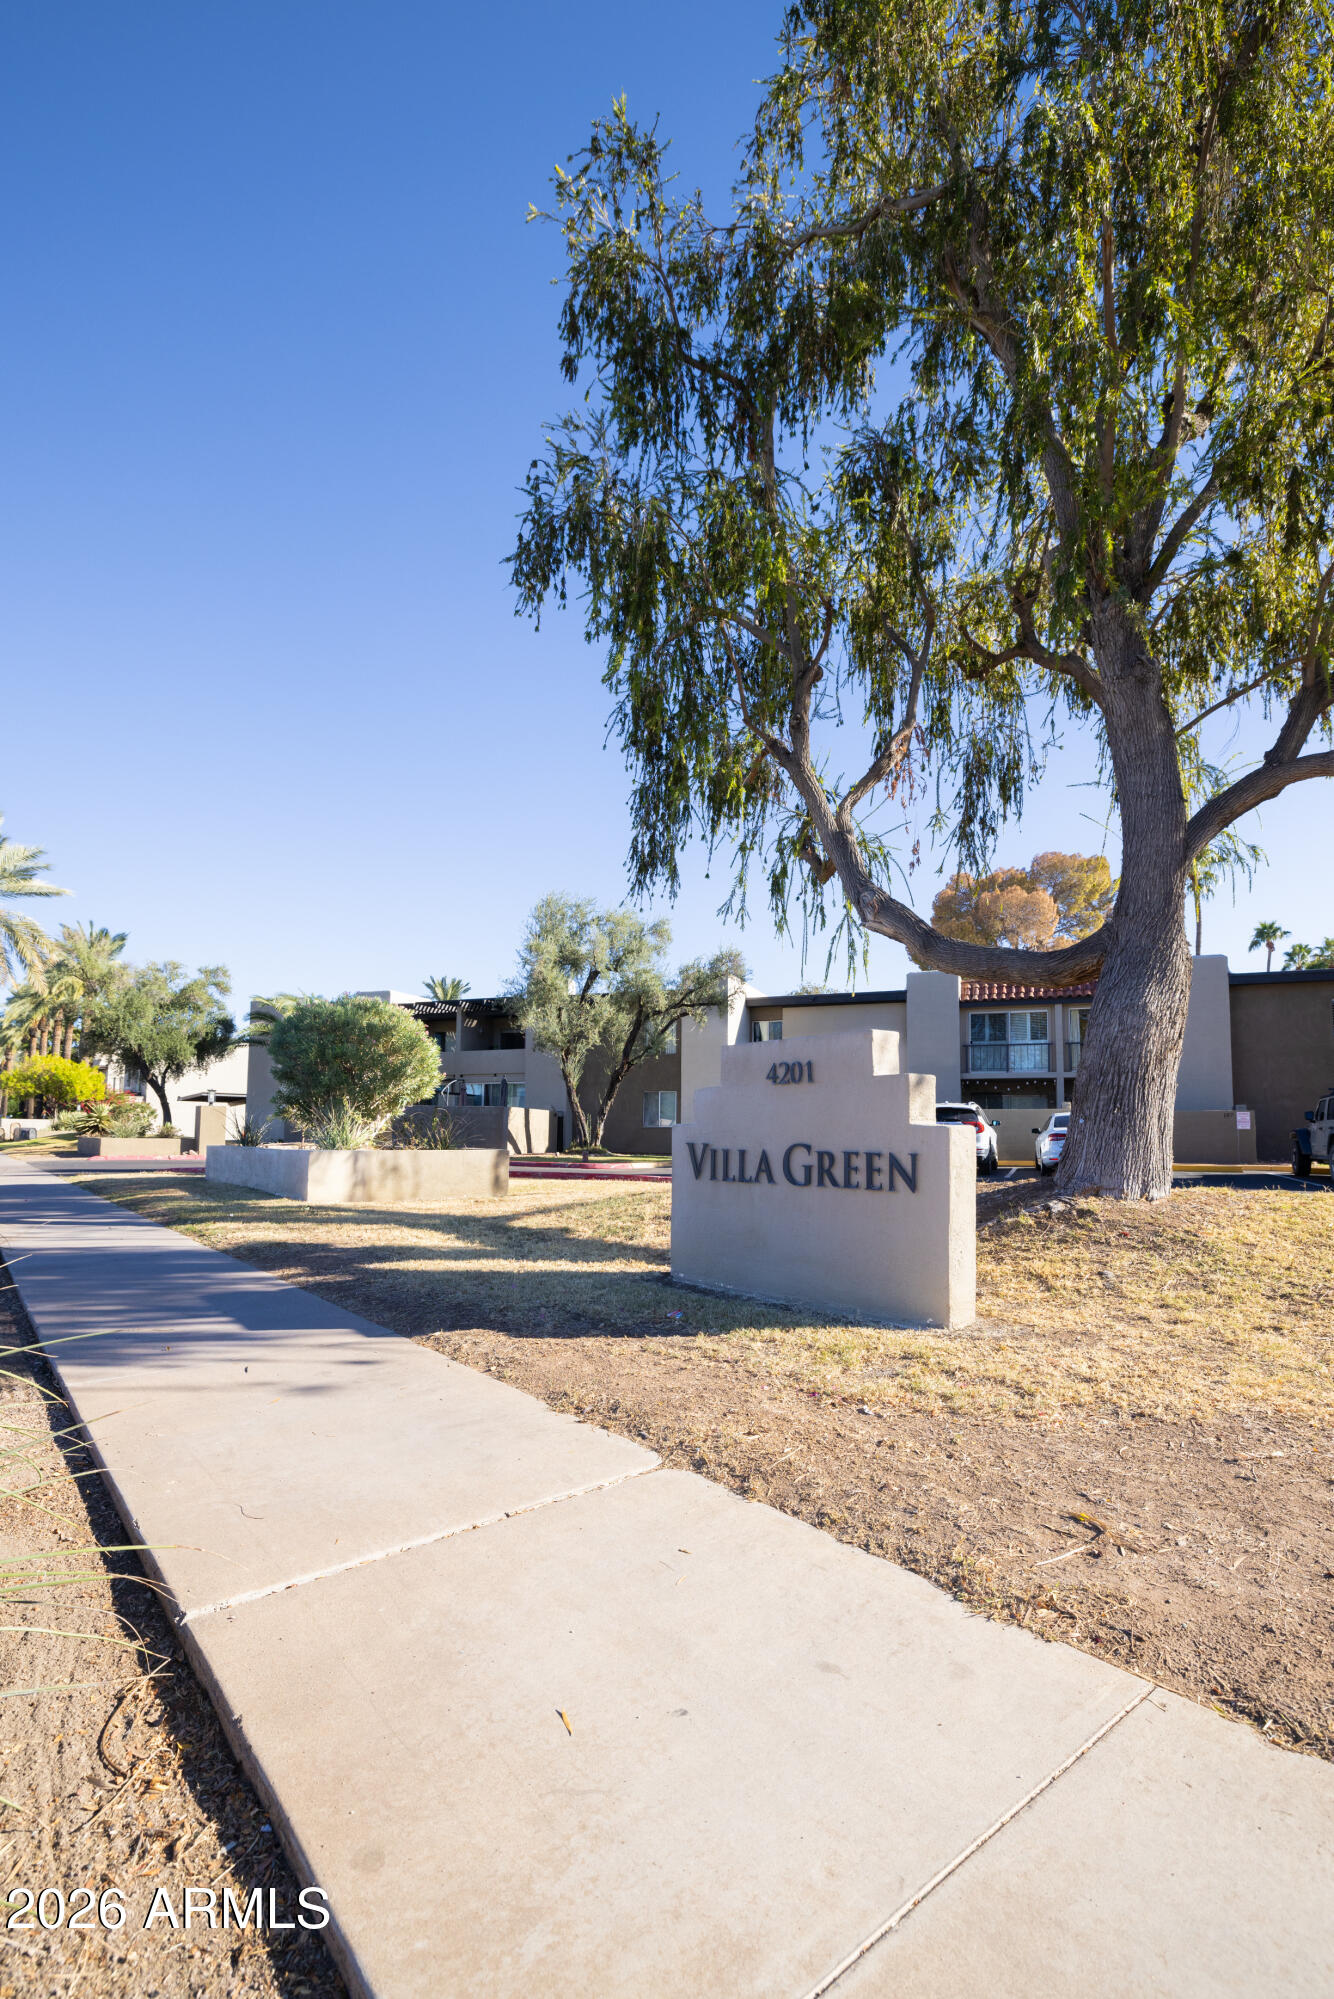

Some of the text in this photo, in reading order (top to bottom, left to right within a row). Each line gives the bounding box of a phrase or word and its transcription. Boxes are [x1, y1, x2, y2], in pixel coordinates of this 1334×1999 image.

[766, 1060, 815, 1085] 4201
[686, 1142, 919, 1194] VILLA GREEN
